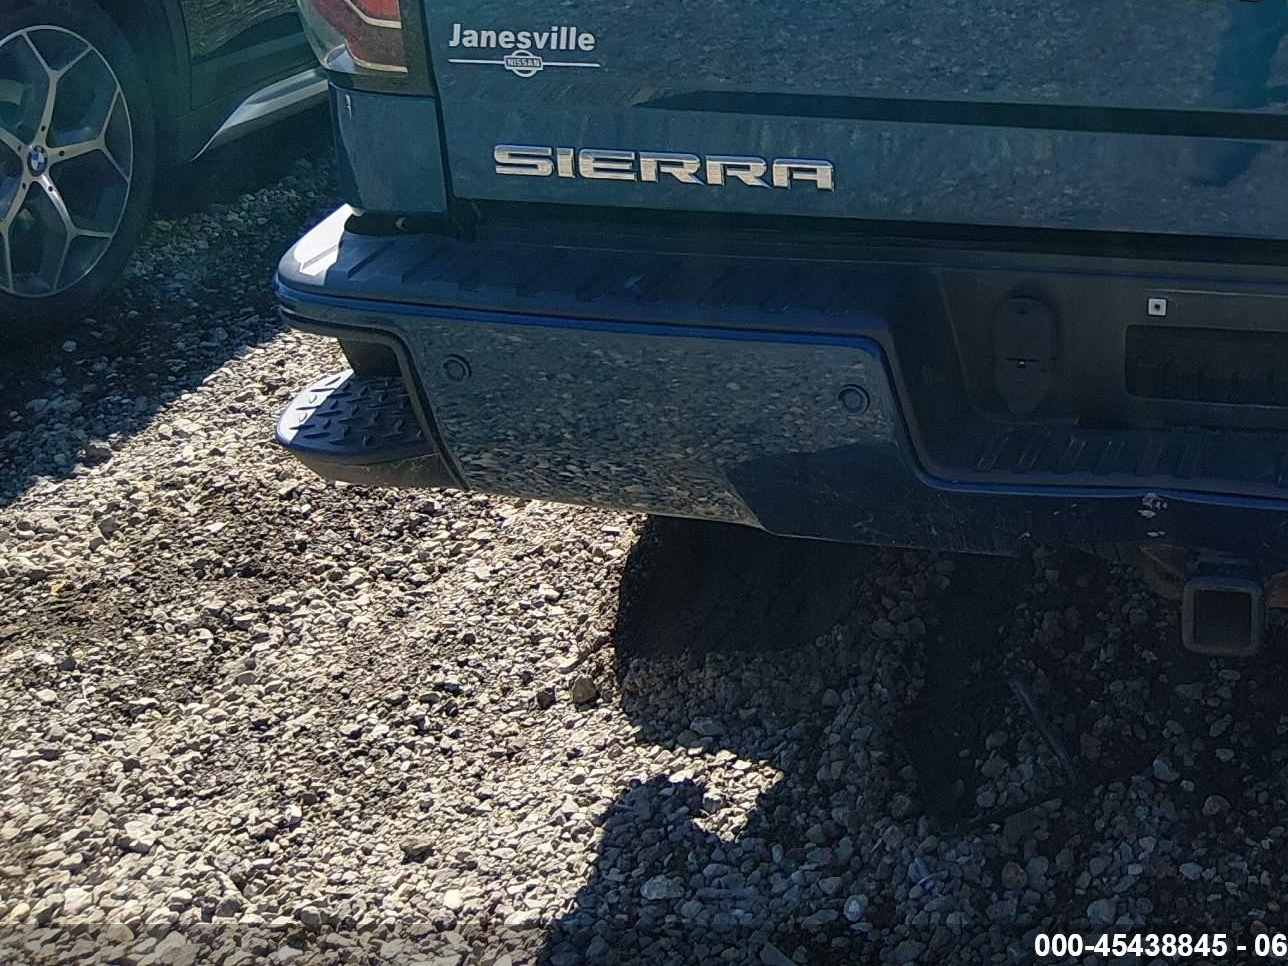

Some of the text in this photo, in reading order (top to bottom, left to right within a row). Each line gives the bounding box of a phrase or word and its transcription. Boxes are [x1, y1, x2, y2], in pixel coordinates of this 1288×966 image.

[449, 23, 596, 51] Janesville
[506, 58, 541, 68] NISSAN
[494, 144, 835, 191] SIERRA
